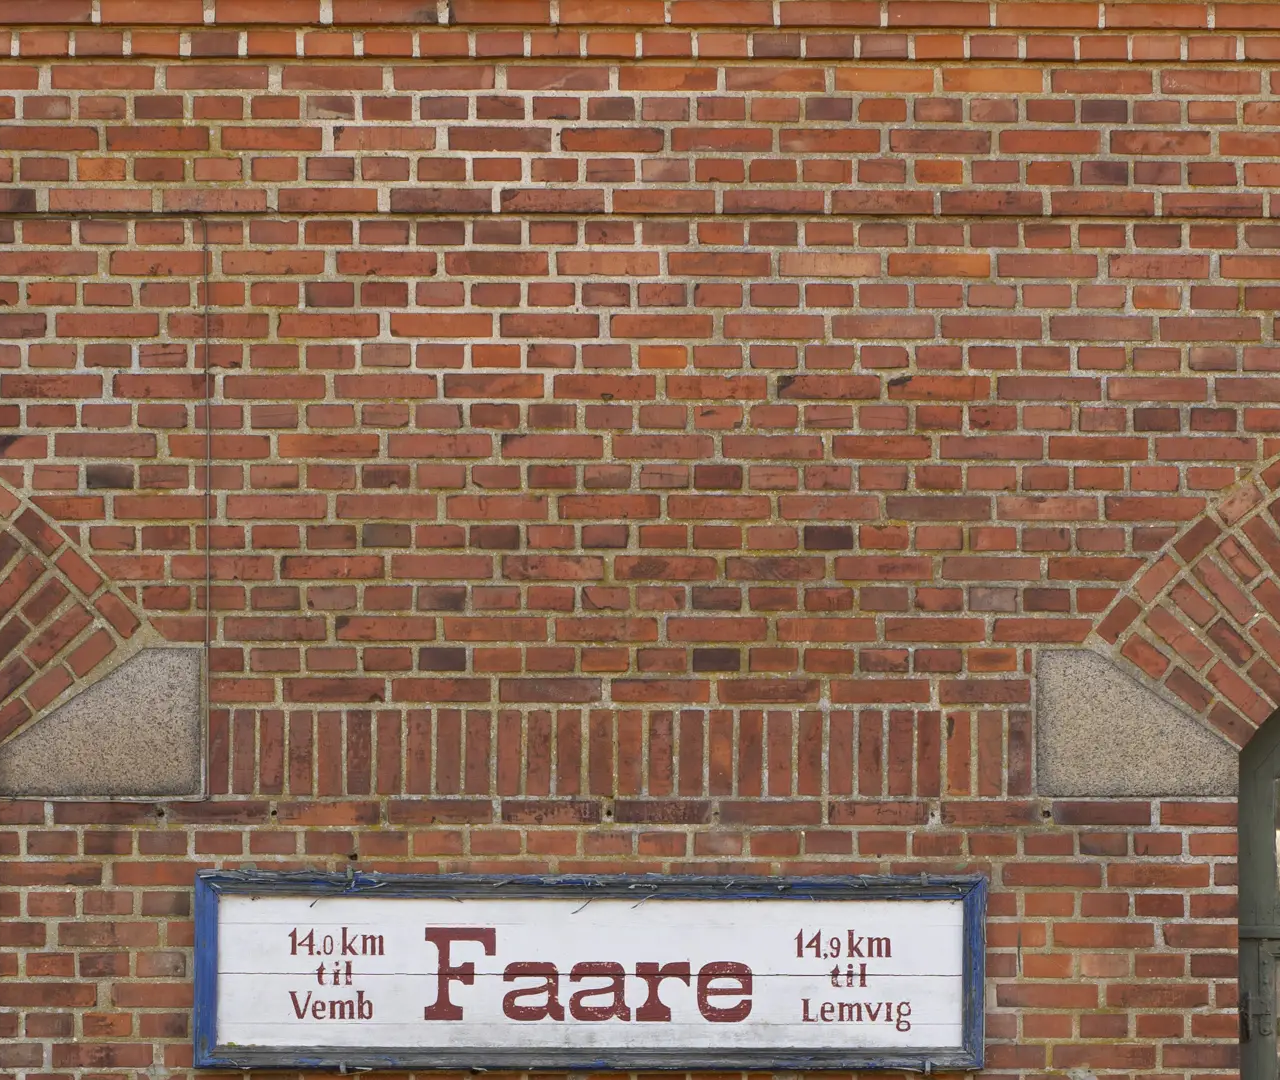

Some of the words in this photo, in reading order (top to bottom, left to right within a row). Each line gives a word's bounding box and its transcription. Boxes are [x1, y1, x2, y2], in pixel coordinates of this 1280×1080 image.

[288, 927, 334, 956] 14.0
[341, 926, 385, 956] km
[794, 928, 841, 959] 14,9
[846, 929, 892, 958] km
[316, 960, 353, 986] til
[424, 927, 754, 1023] Faare
[830, 963, 867, 988] til
[288, 990, 373, 1020] Vemb
[801, 998, 912, 1032] Lemvig
